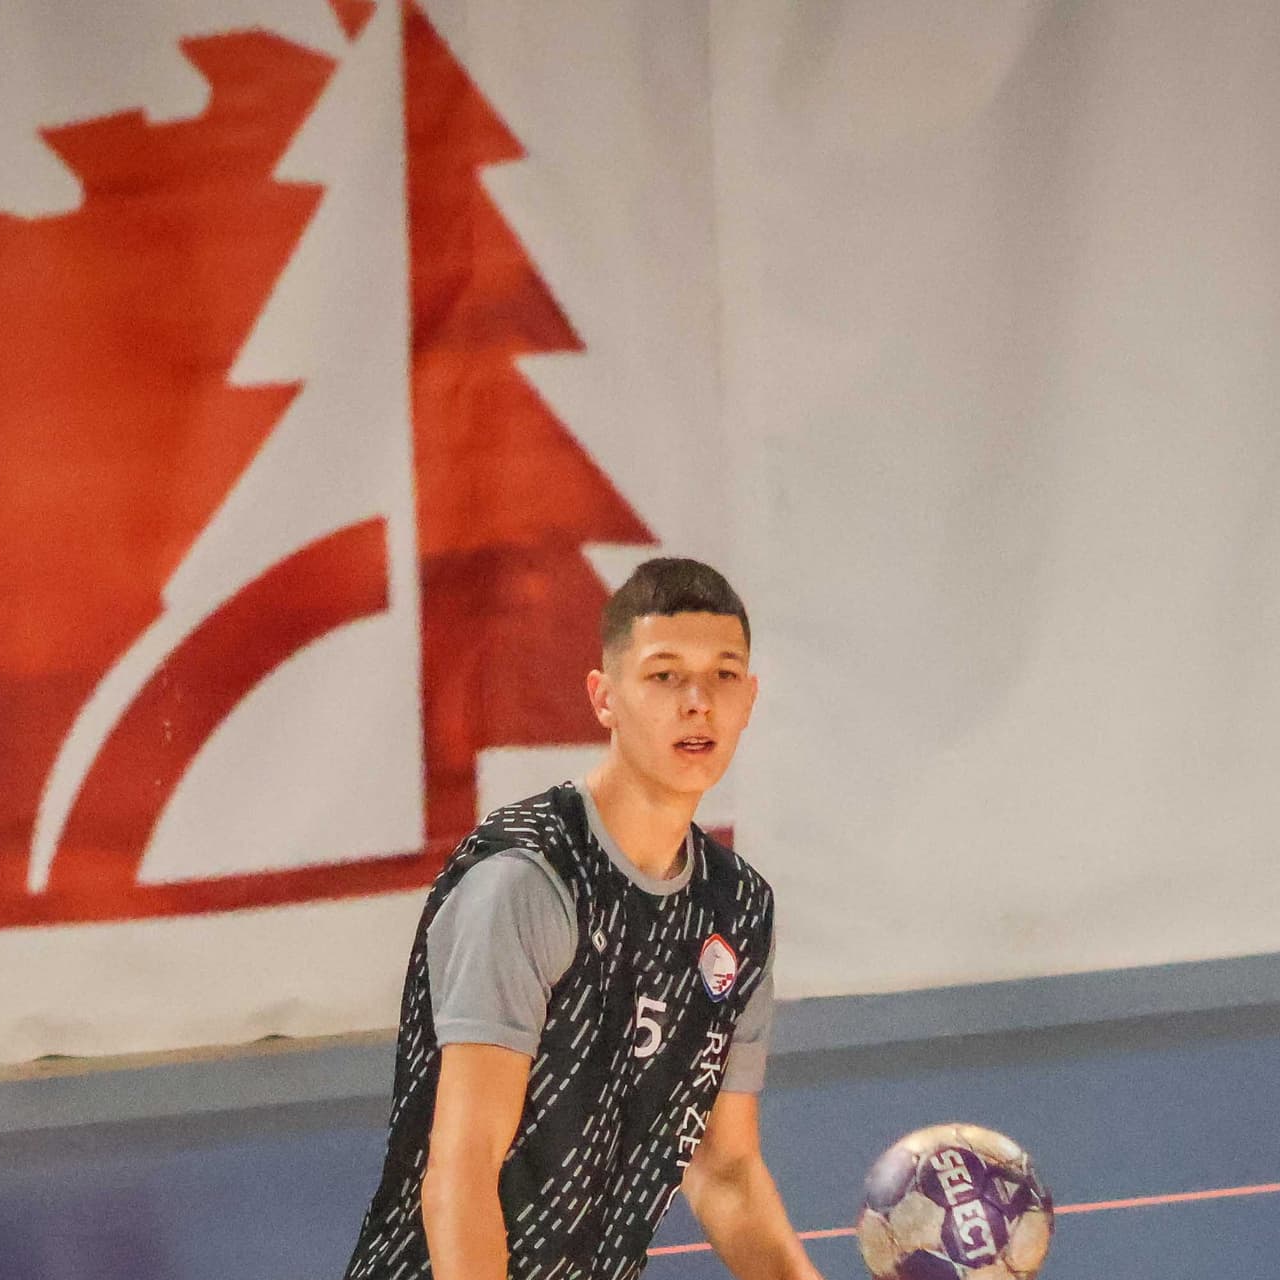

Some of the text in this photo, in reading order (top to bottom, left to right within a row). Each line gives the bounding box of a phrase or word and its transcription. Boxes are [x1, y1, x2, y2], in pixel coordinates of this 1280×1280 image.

[634, 996, 667, 1058] 5
[693, 1031, 723, 1087] RK
[930, 1149, 997, 1260] SELECT
